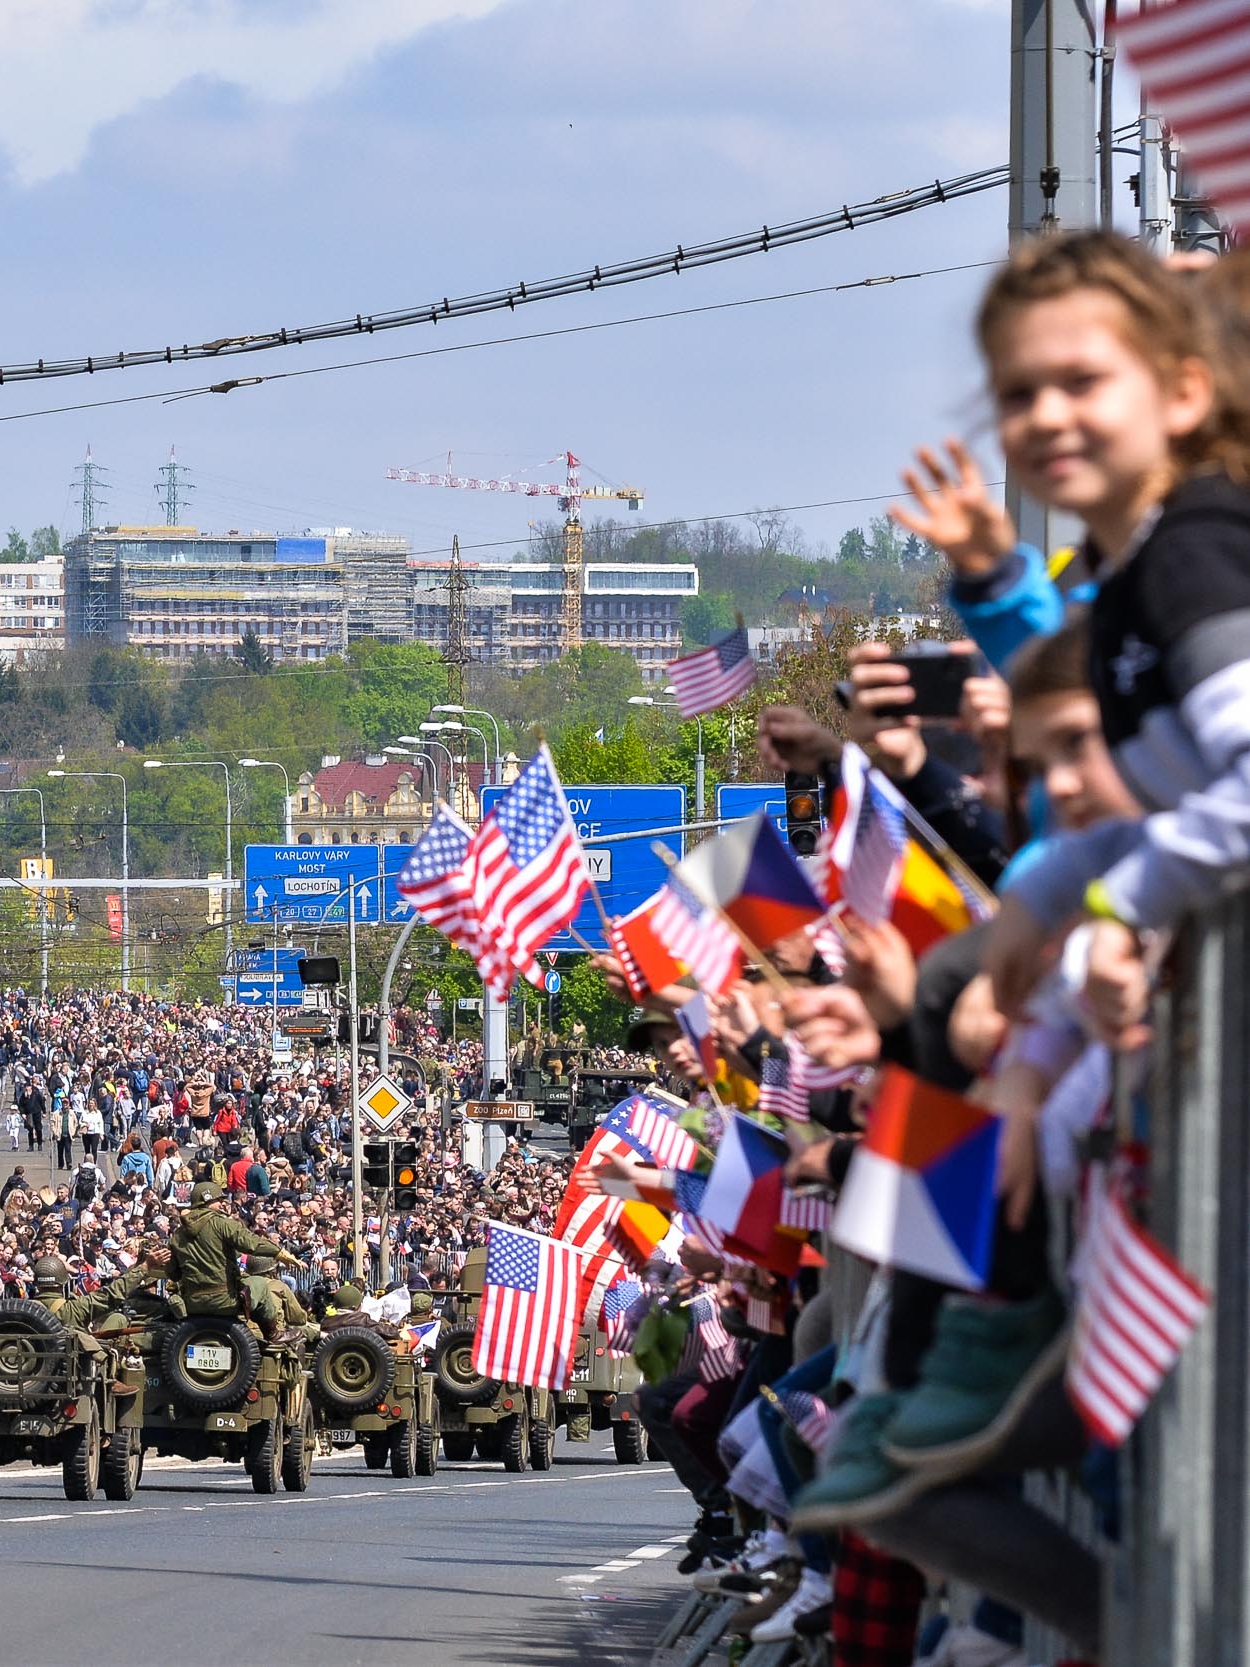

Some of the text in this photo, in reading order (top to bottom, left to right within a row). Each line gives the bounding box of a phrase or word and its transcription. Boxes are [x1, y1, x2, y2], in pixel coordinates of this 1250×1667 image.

[274, 851, 350, 860] KARLOVY VARY
[298, 864, 326, 873] MOST
[287, 880, 337, 891] LOCHOTÍN
[285, 908, 295, 916] 20
[307, 908, 317, 916] 27
[473, 1106, 513, 1114] ZOO Plzeň
[216, 1418, 236, 1428] D-4
